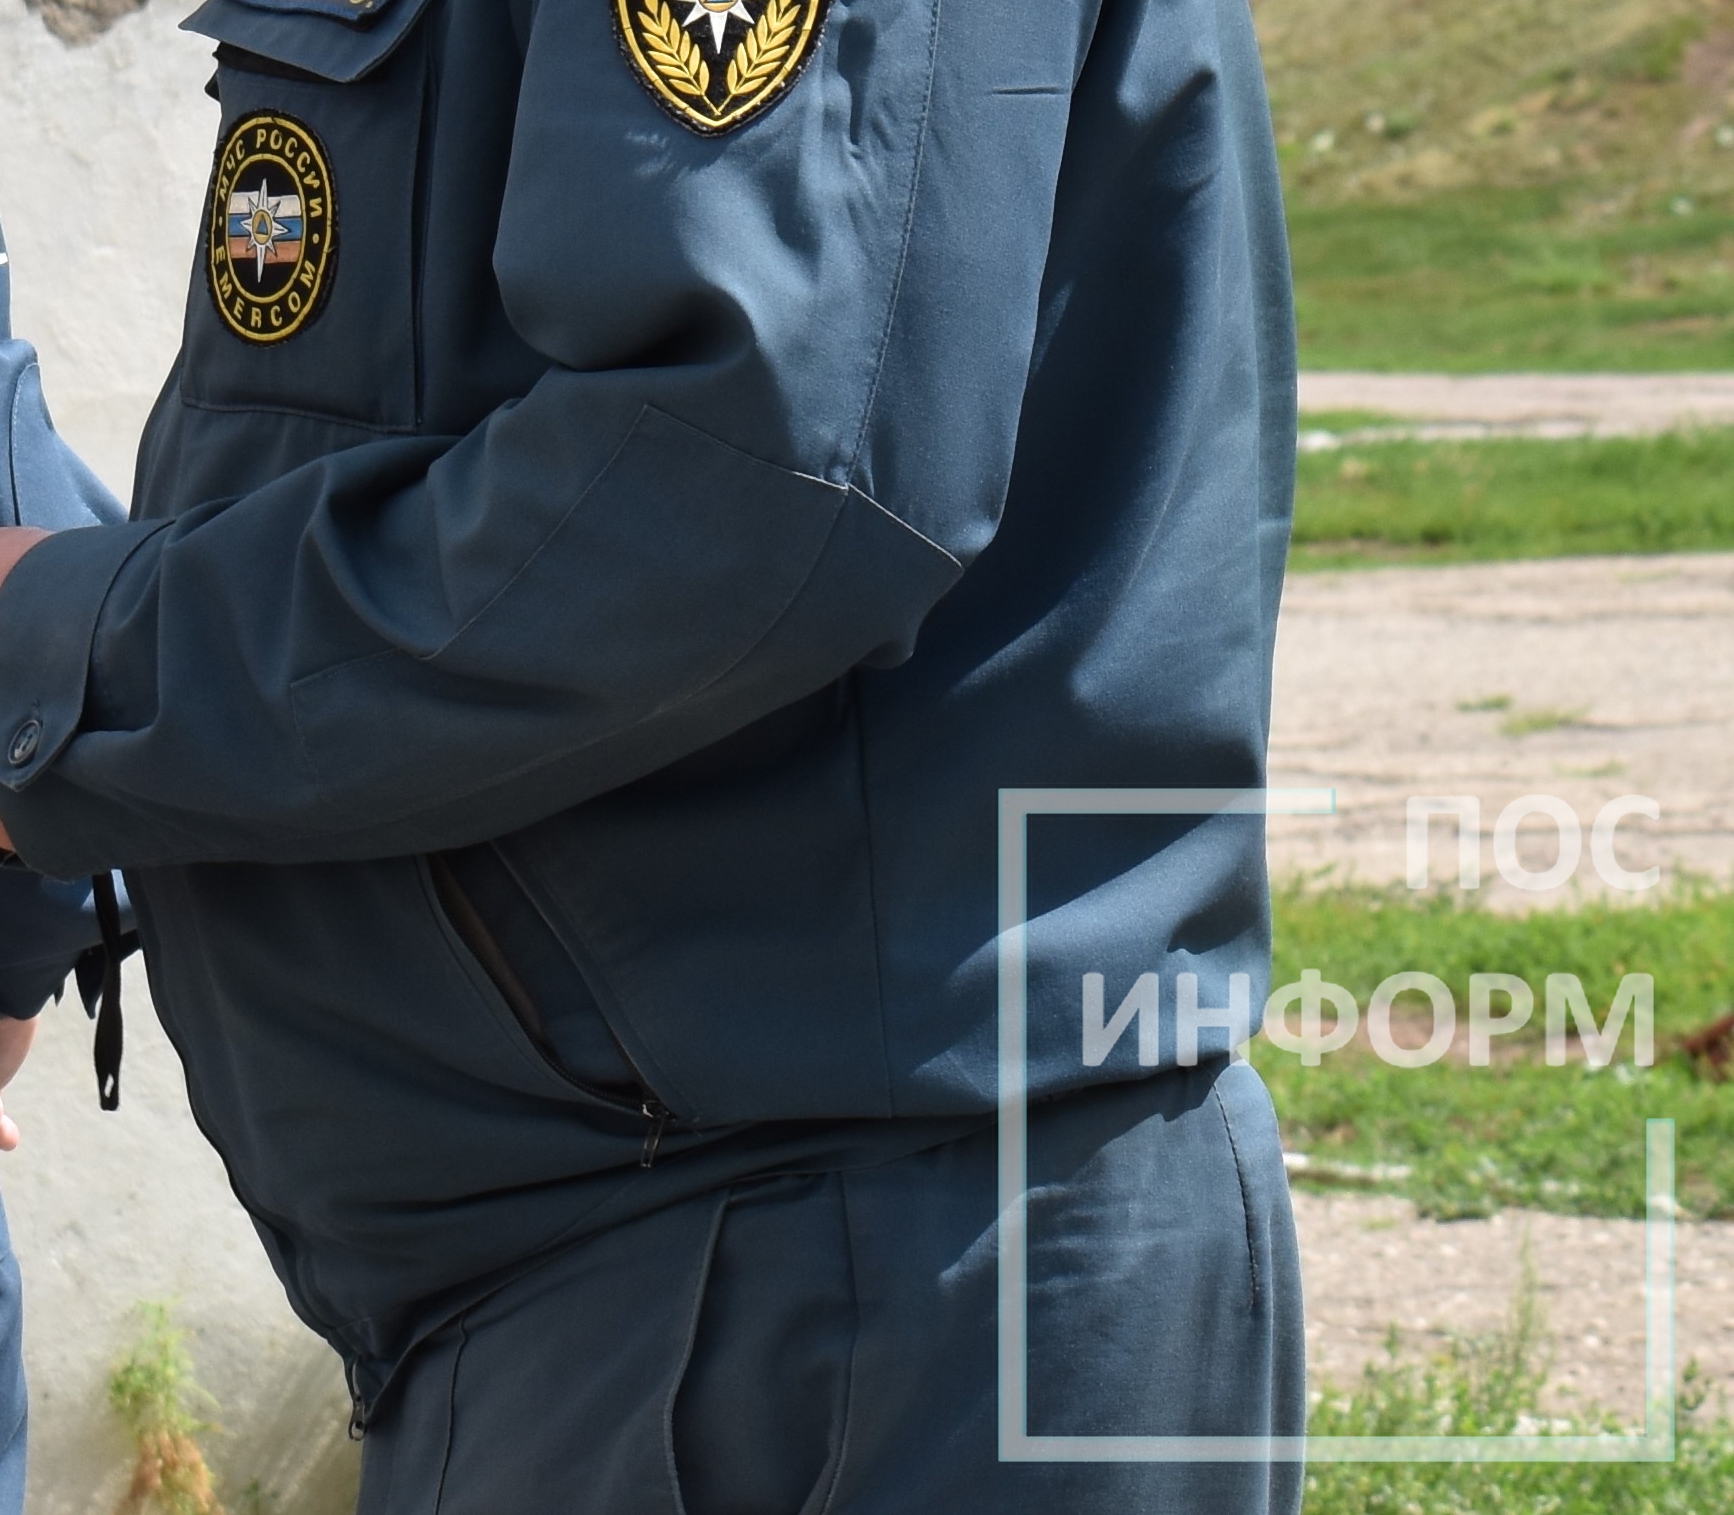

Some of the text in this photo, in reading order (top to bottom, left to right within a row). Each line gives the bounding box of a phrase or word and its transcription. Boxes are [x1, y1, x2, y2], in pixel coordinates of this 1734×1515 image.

[219, 128, 323, 217] МЧС РОССИИ
[214, 247, 317, 329] EMERCOM
